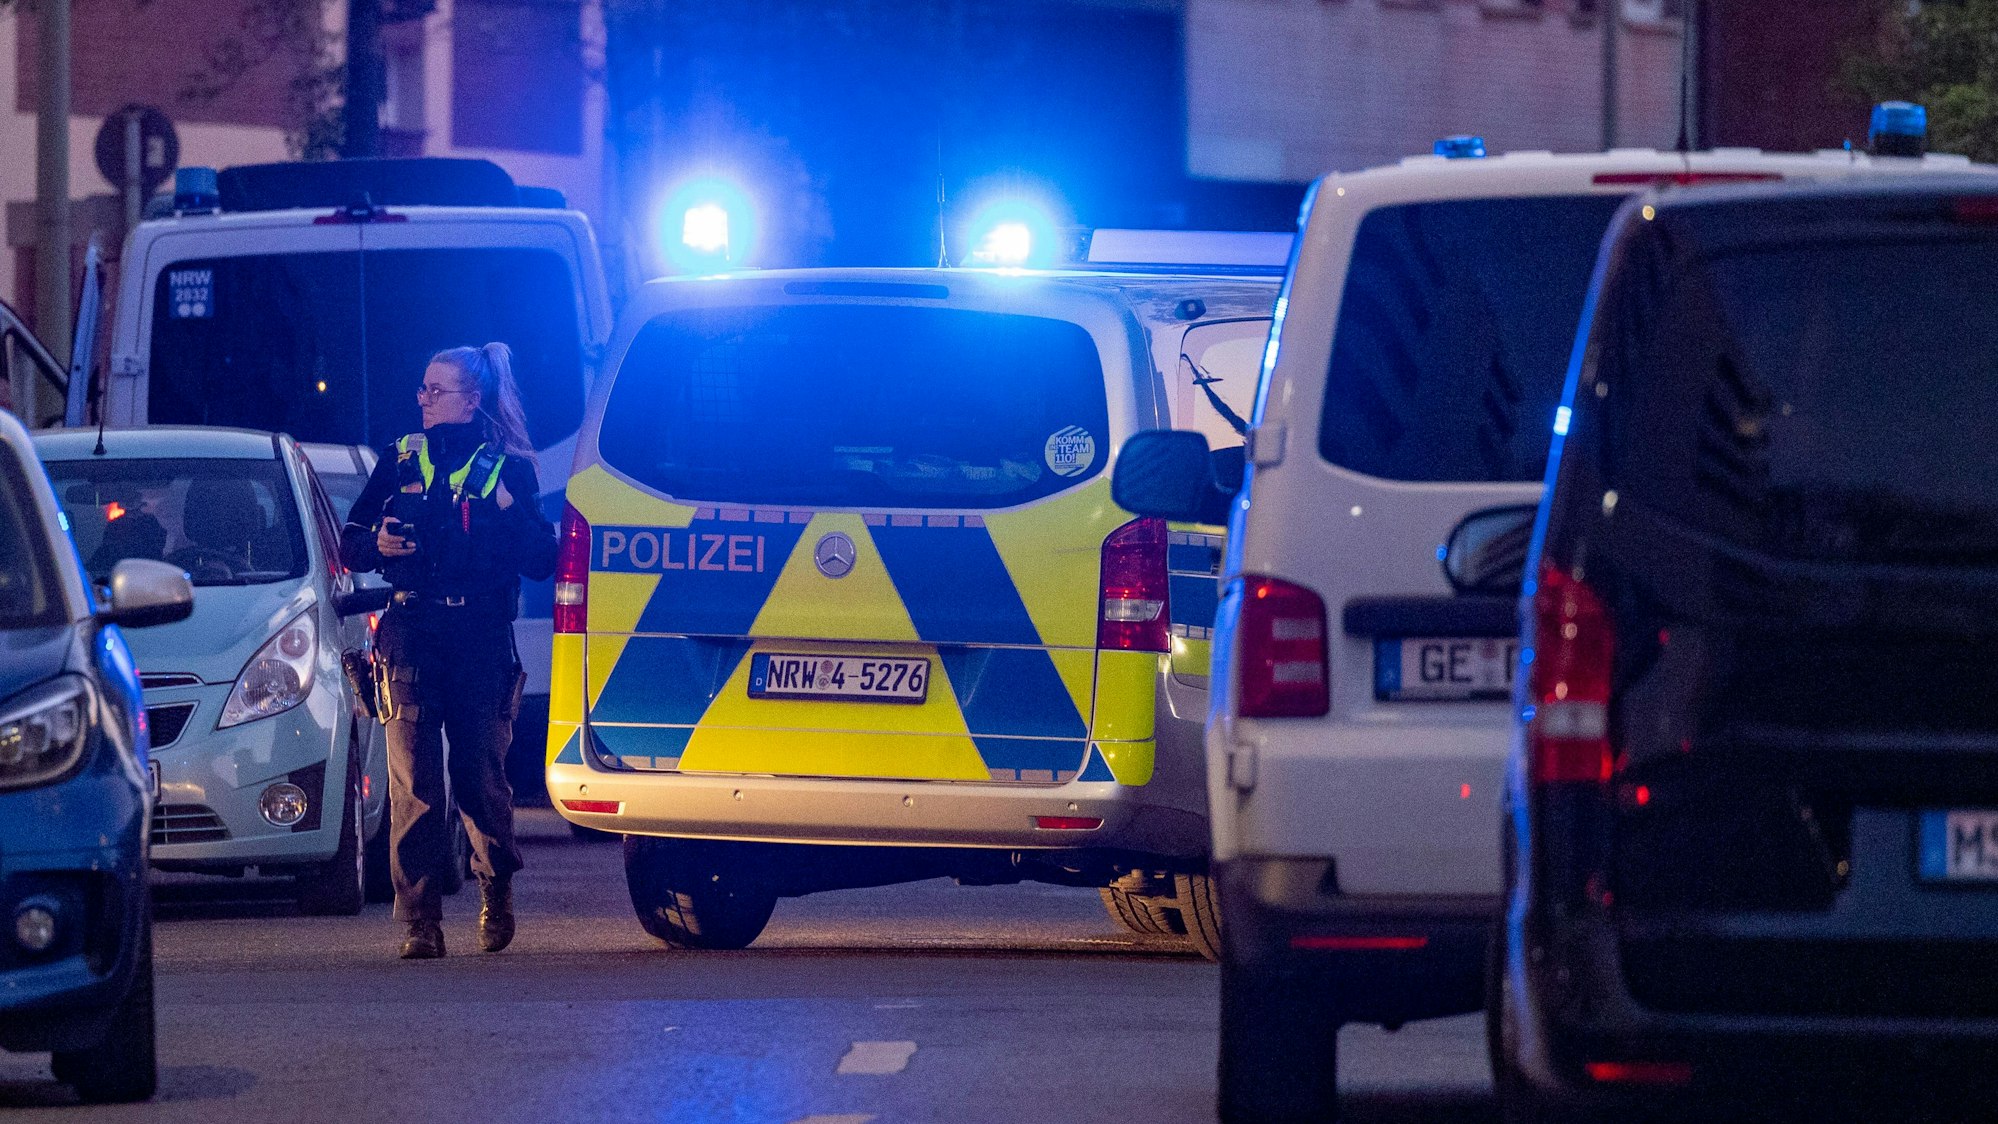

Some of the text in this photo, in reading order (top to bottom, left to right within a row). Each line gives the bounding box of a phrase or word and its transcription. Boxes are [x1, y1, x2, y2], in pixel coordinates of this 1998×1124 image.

[170, 271, 212, 287] NRW
[1055, 436, 1085, 445] KOMM
[1058, 444, 1090, 454] TEAM
[1055, 454, 1076, 464] 110!
[602, 531, 765, 573] POLIZEI
[1420, 644, 1473, 683] GE
[767, 659, 924, 692] NRW 4-5276
